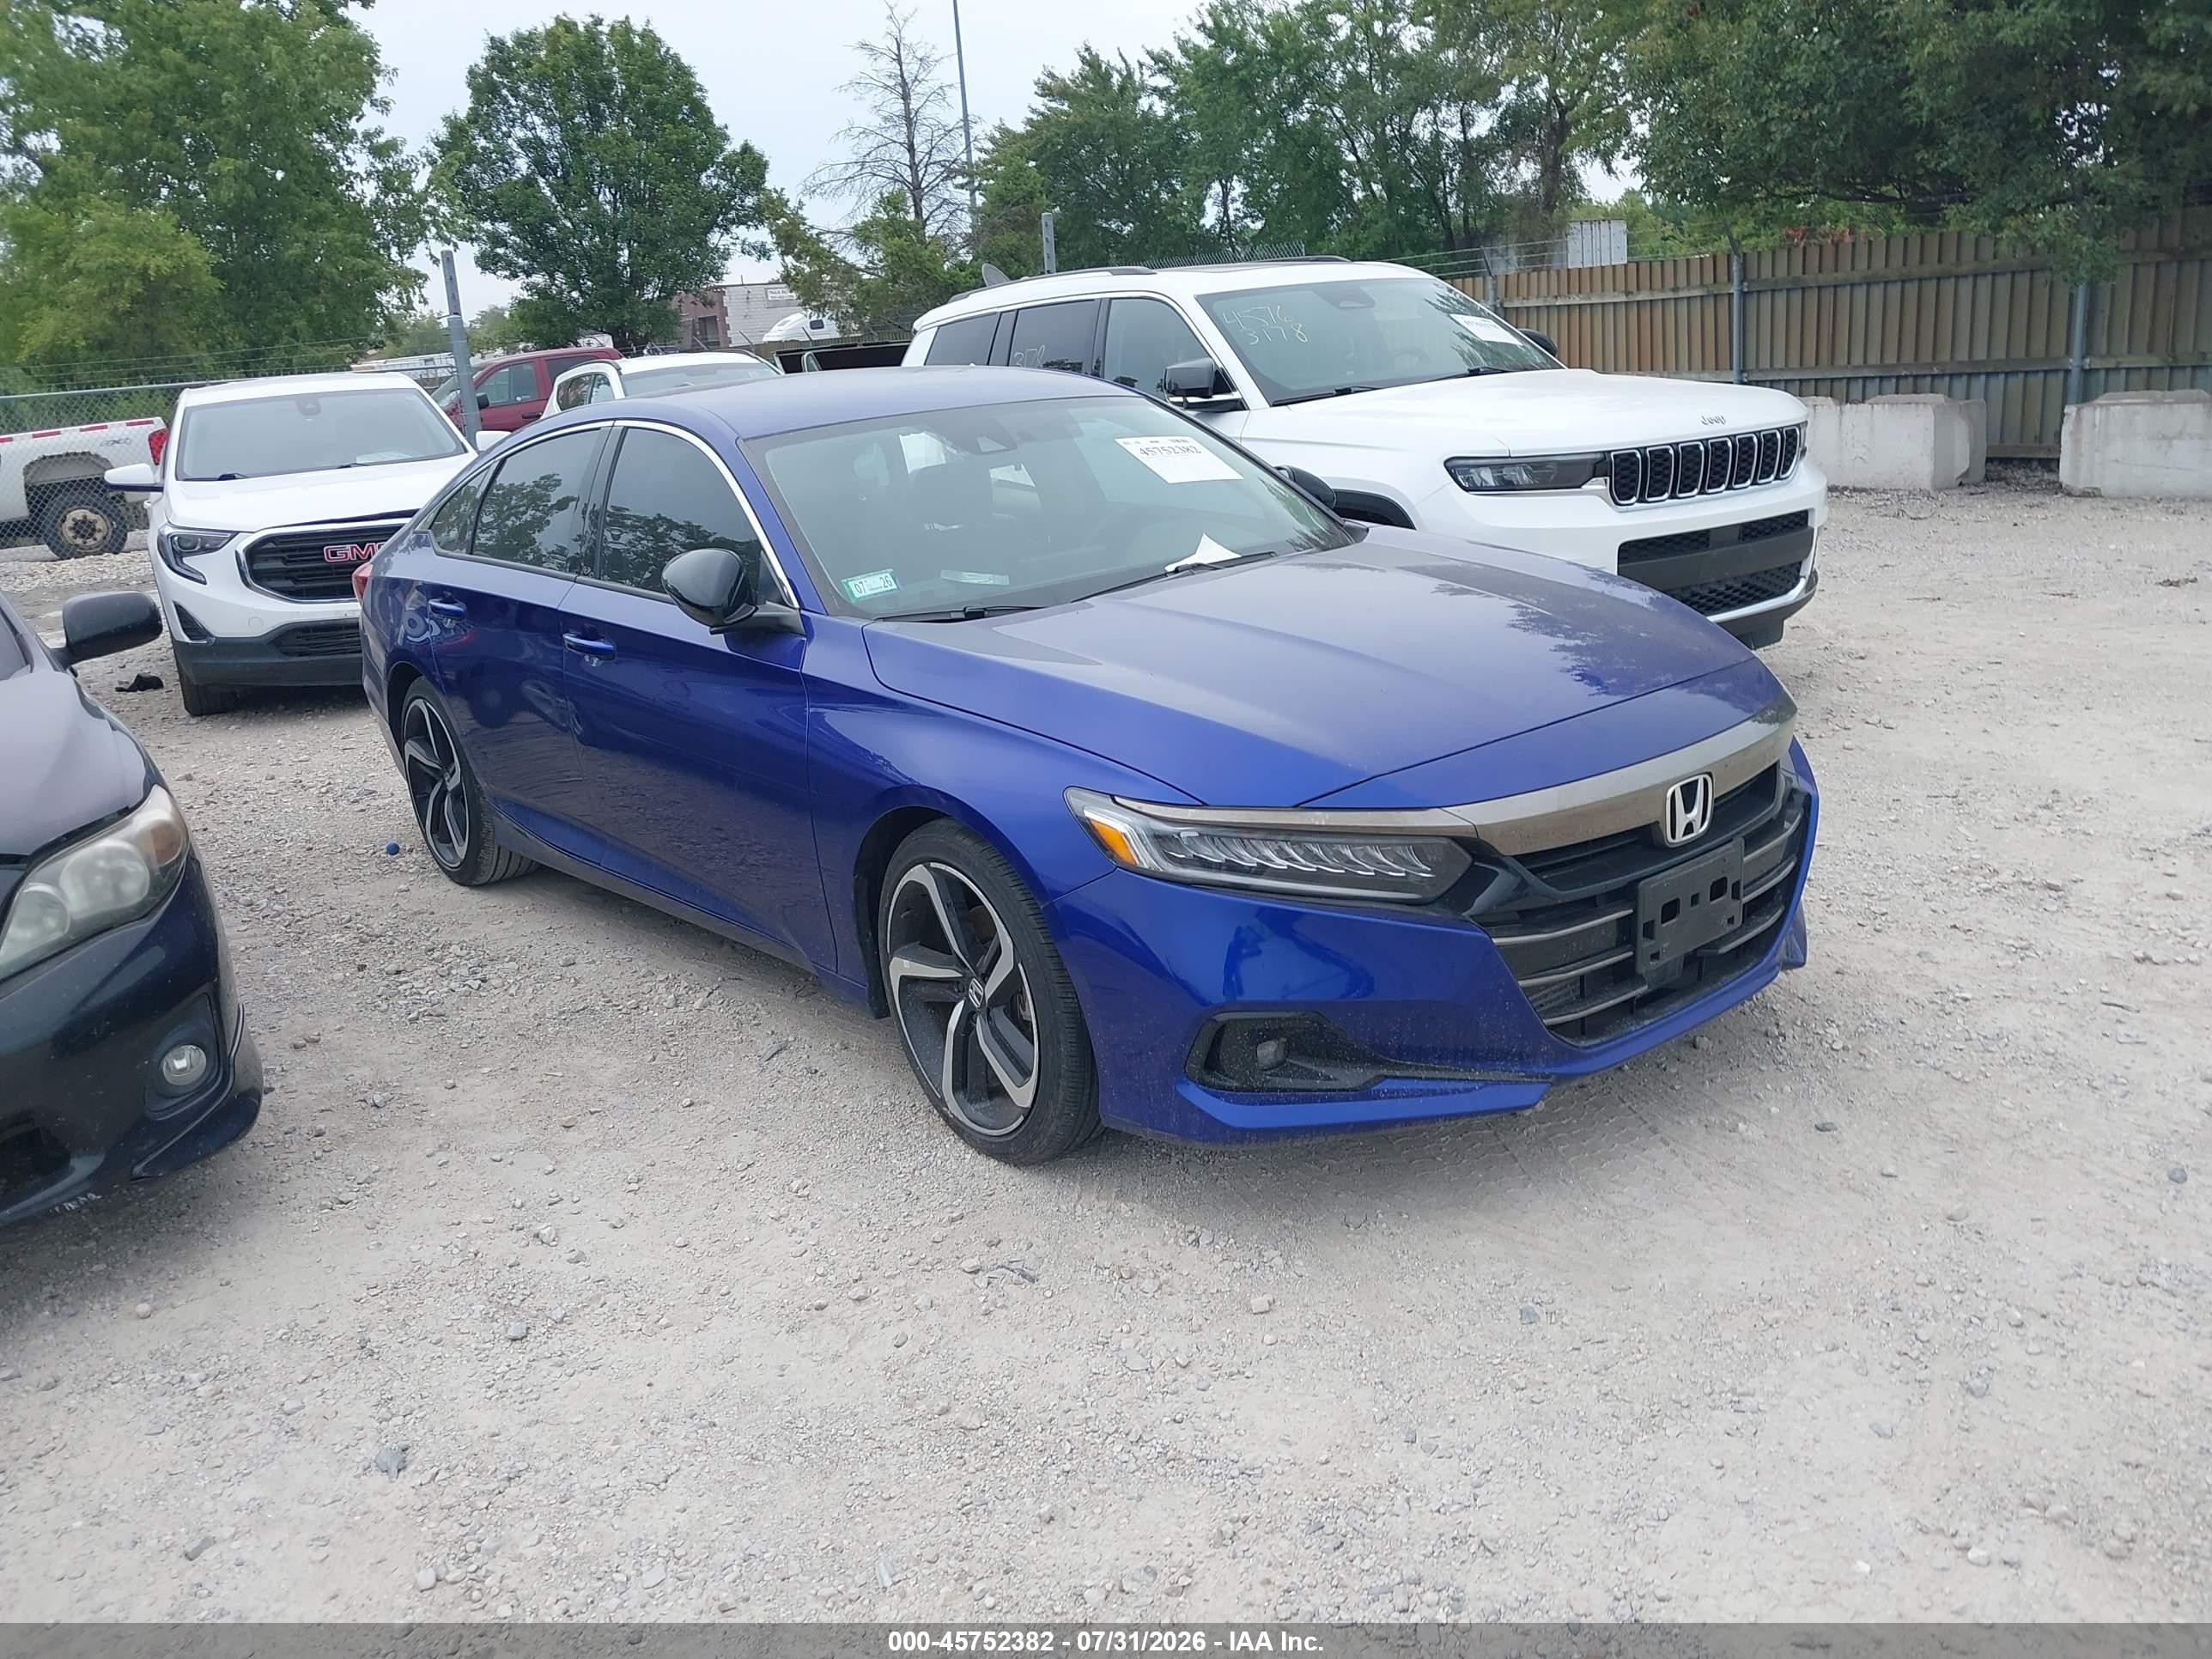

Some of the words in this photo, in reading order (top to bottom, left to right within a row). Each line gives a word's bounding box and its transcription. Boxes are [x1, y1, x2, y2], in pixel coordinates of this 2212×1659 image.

[1222, 305, 1294, 329] 4576
[1248, 323, 1308, 345] 3178
[1700, 415, 1726, 426] Jeep
[1139, 445, 1202, 457] 45752382
[854, 580, 867, 594] 07
[878, 575, 893, 589] 26
